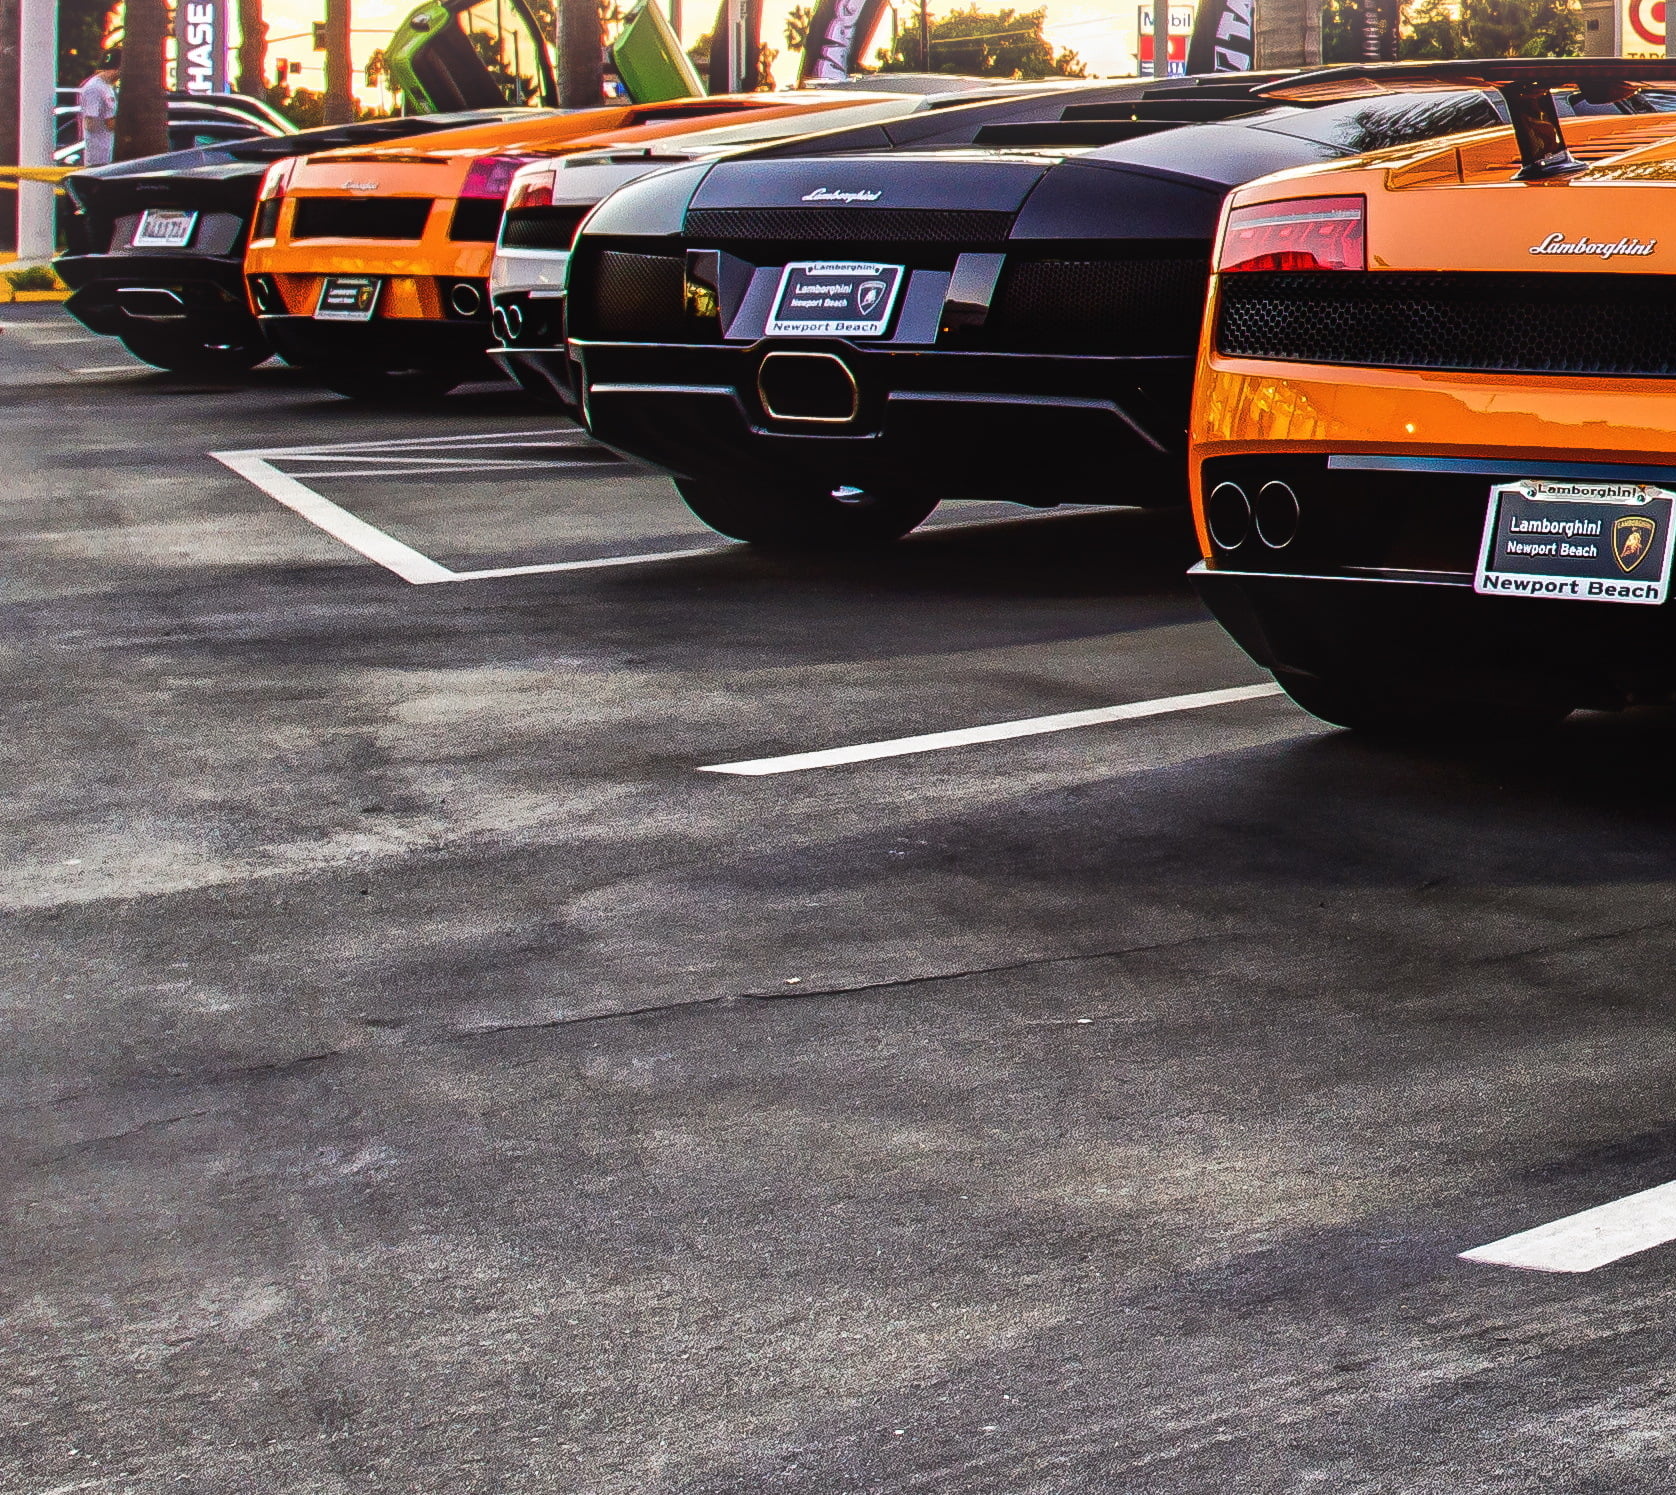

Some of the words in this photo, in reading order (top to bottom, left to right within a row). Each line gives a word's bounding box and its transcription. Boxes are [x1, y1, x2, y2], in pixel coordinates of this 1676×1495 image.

[1143, 11, 1191, 28] Mbil
[186, 2, 214, 96] HASE
[1528, 232, 1657, 259] Lamborghini
[773, 322, 830, 333] Newport
[834, 322, 879, 332] Beach
[1537, 483, 1637, 498] Lamborghini
[1510, 516, 1601, 538] Lamborghini
[1506, 540, 1558, 555] Newport
[1560, 543, 1598, 557] Beach
[1482, 574, 1580, 595] Newport
[1587, 583, 1660, 600] Beach
